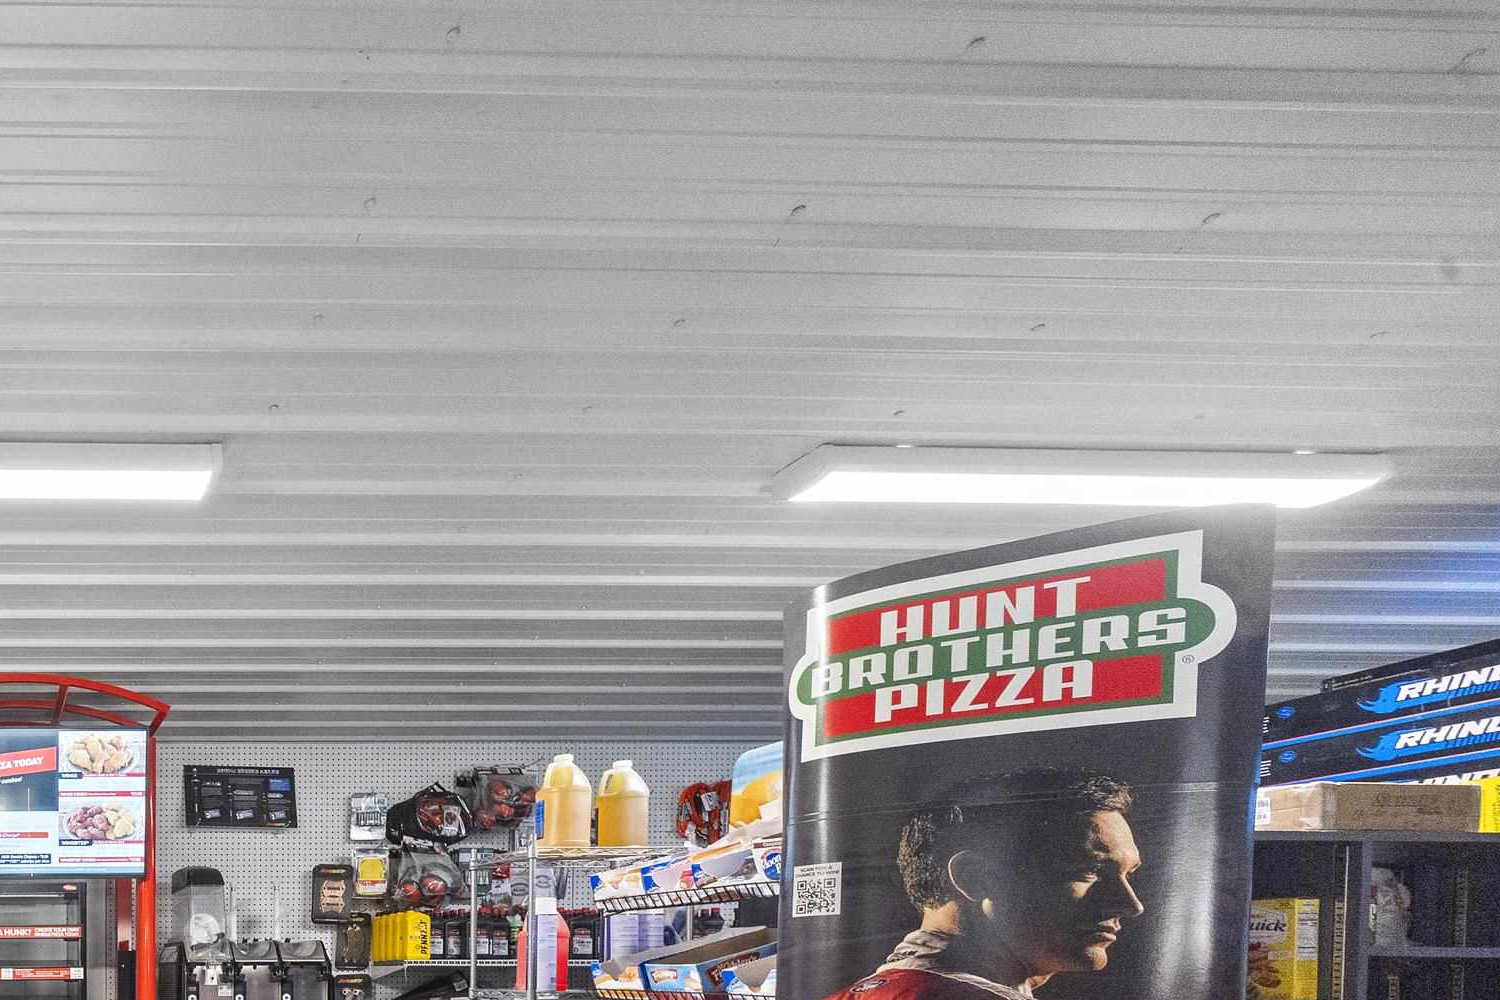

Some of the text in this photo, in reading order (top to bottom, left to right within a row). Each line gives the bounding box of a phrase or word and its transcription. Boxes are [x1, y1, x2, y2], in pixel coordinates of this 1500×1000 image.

[880, 576, 1091, 647] HUNT
[811, 607, 1187, 699] BROTHERS
[874, 659, 1093, 723] PIZZA
[13, 757, 44, 768] TODAY
[1250, 919, 1286, 932] uick
